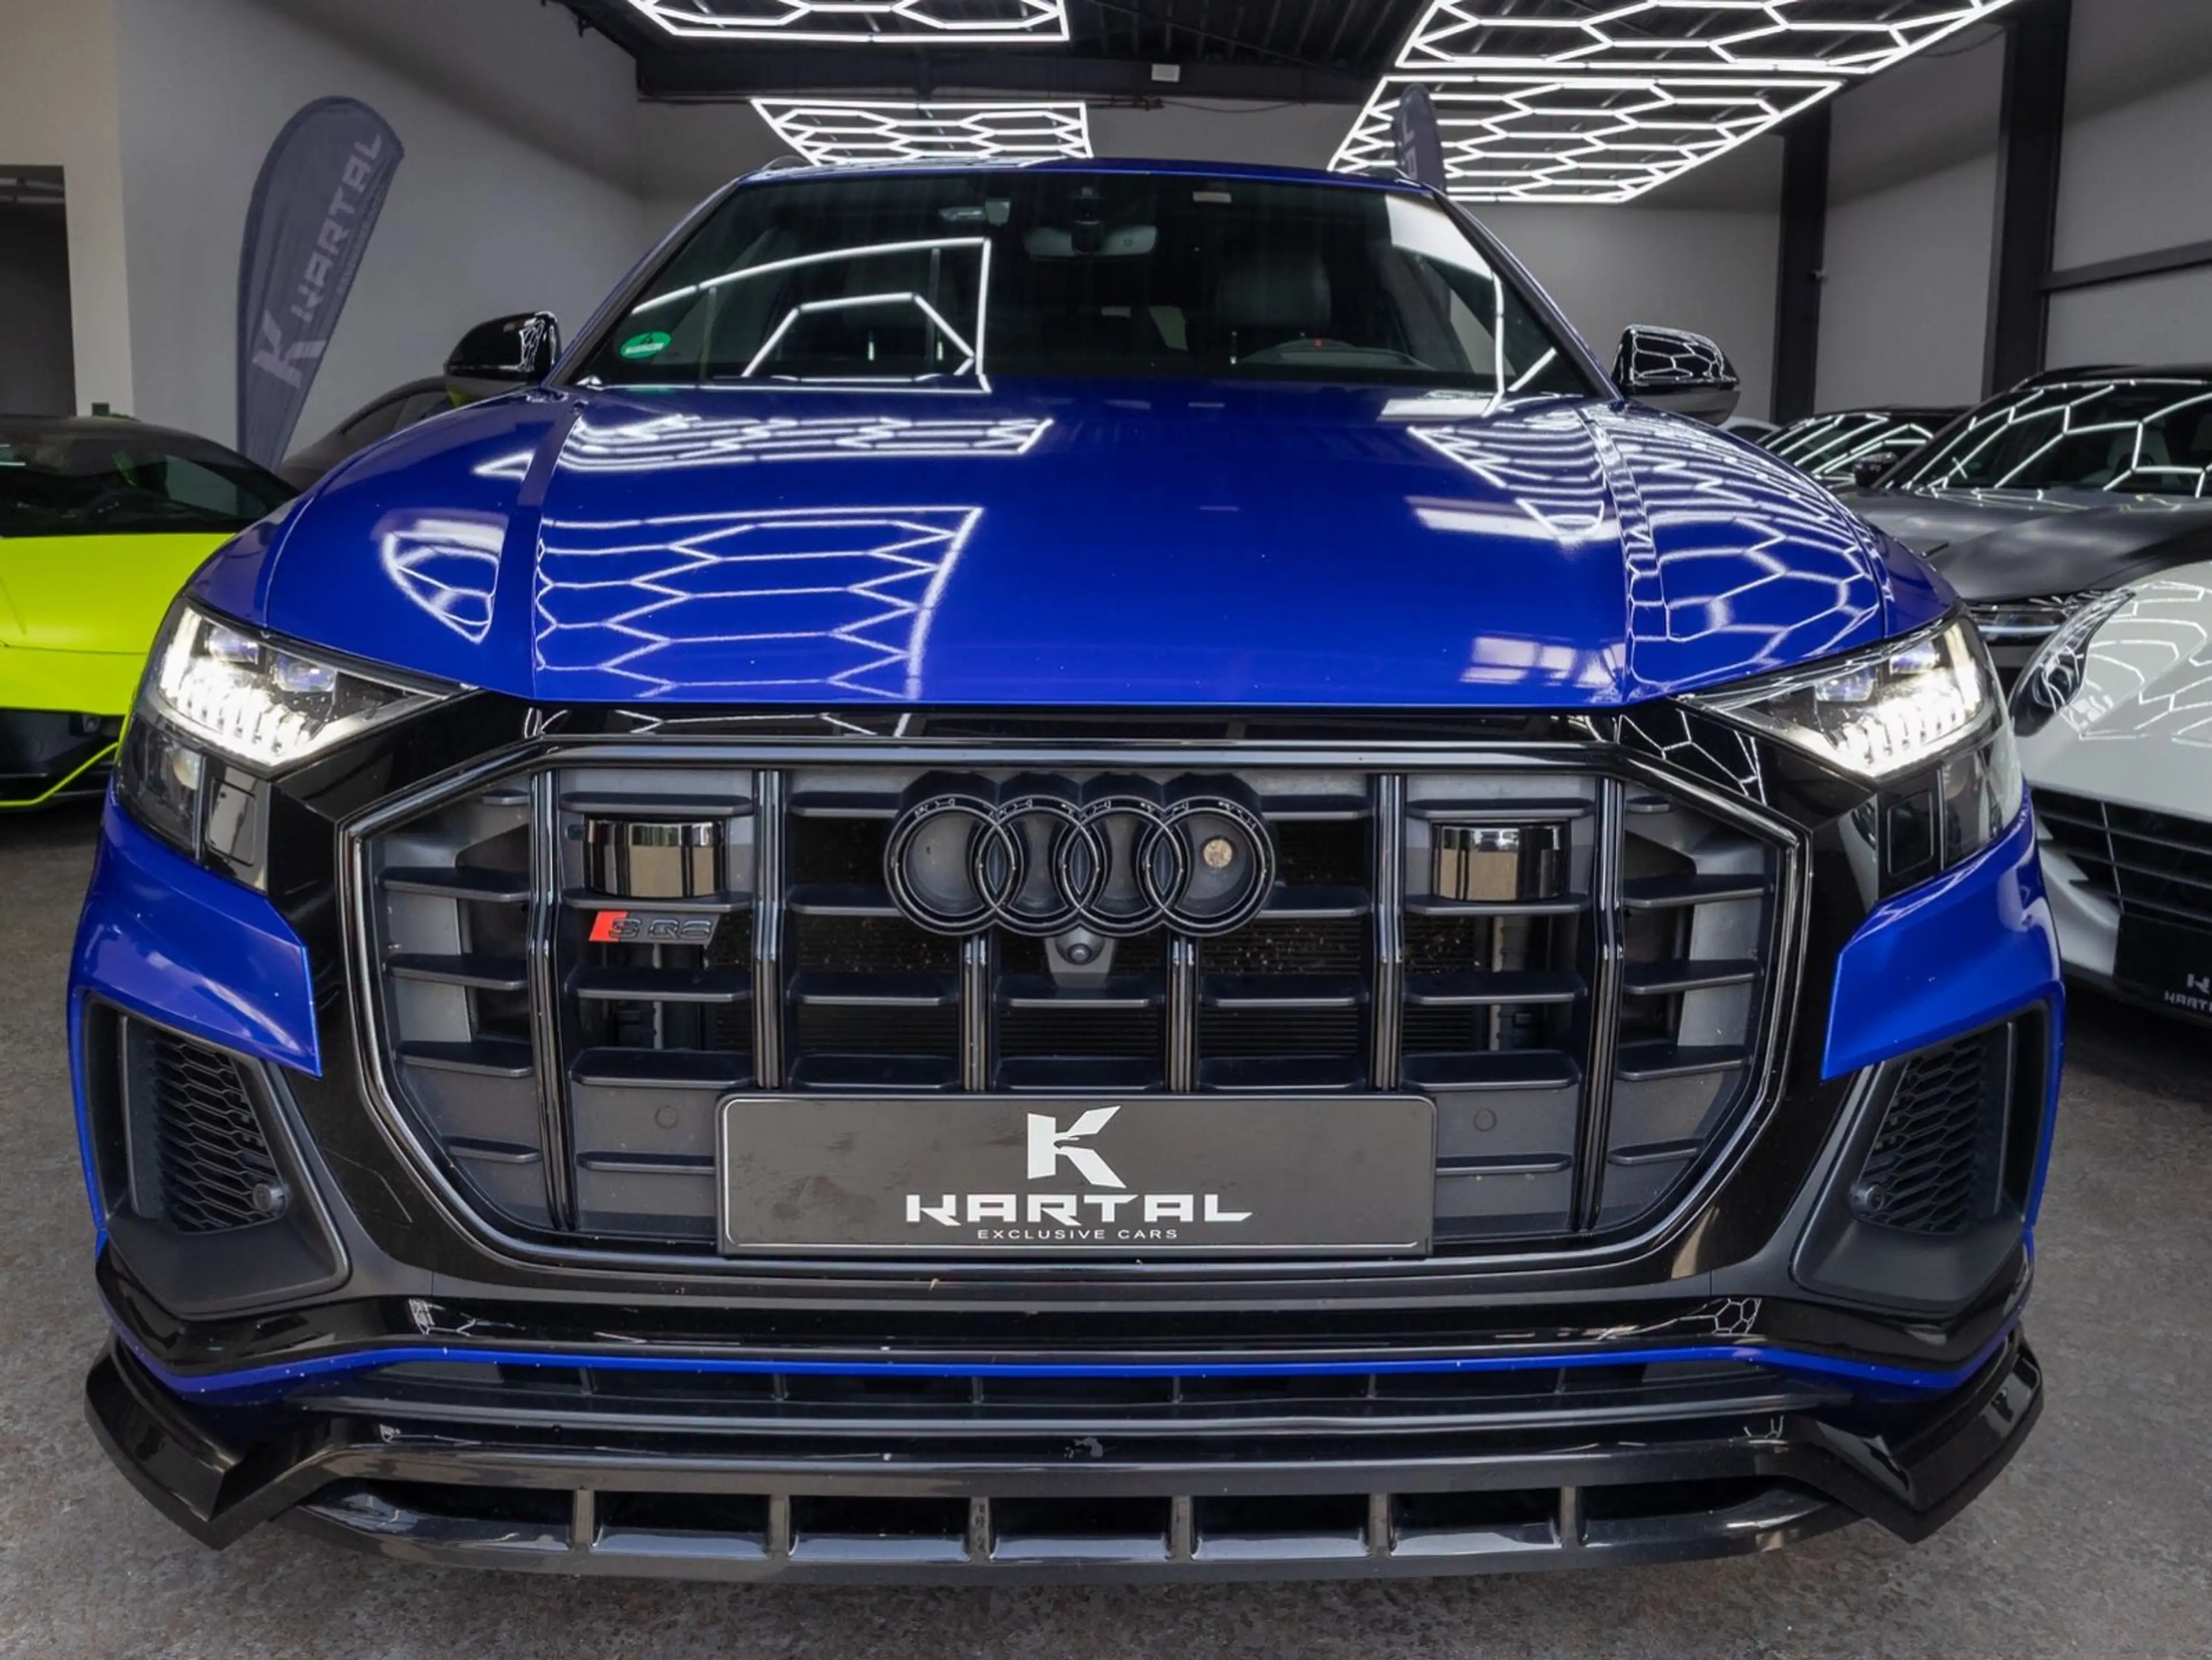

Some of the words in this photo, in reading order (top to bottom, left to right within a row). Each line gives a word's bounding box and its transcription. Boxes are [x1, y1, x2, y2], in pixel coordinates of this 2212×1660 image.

[252, 309, 327, 388] K
[291, 133, 382, 323] KARTAL
[1027, 1105, 1128, 1189] K
[906, 1194, 1253, 1227] KARTAL
[977, 1229, 1105, 1239] EXCLUSIVE
[1117, 1229, 1178, 1239] CARS
